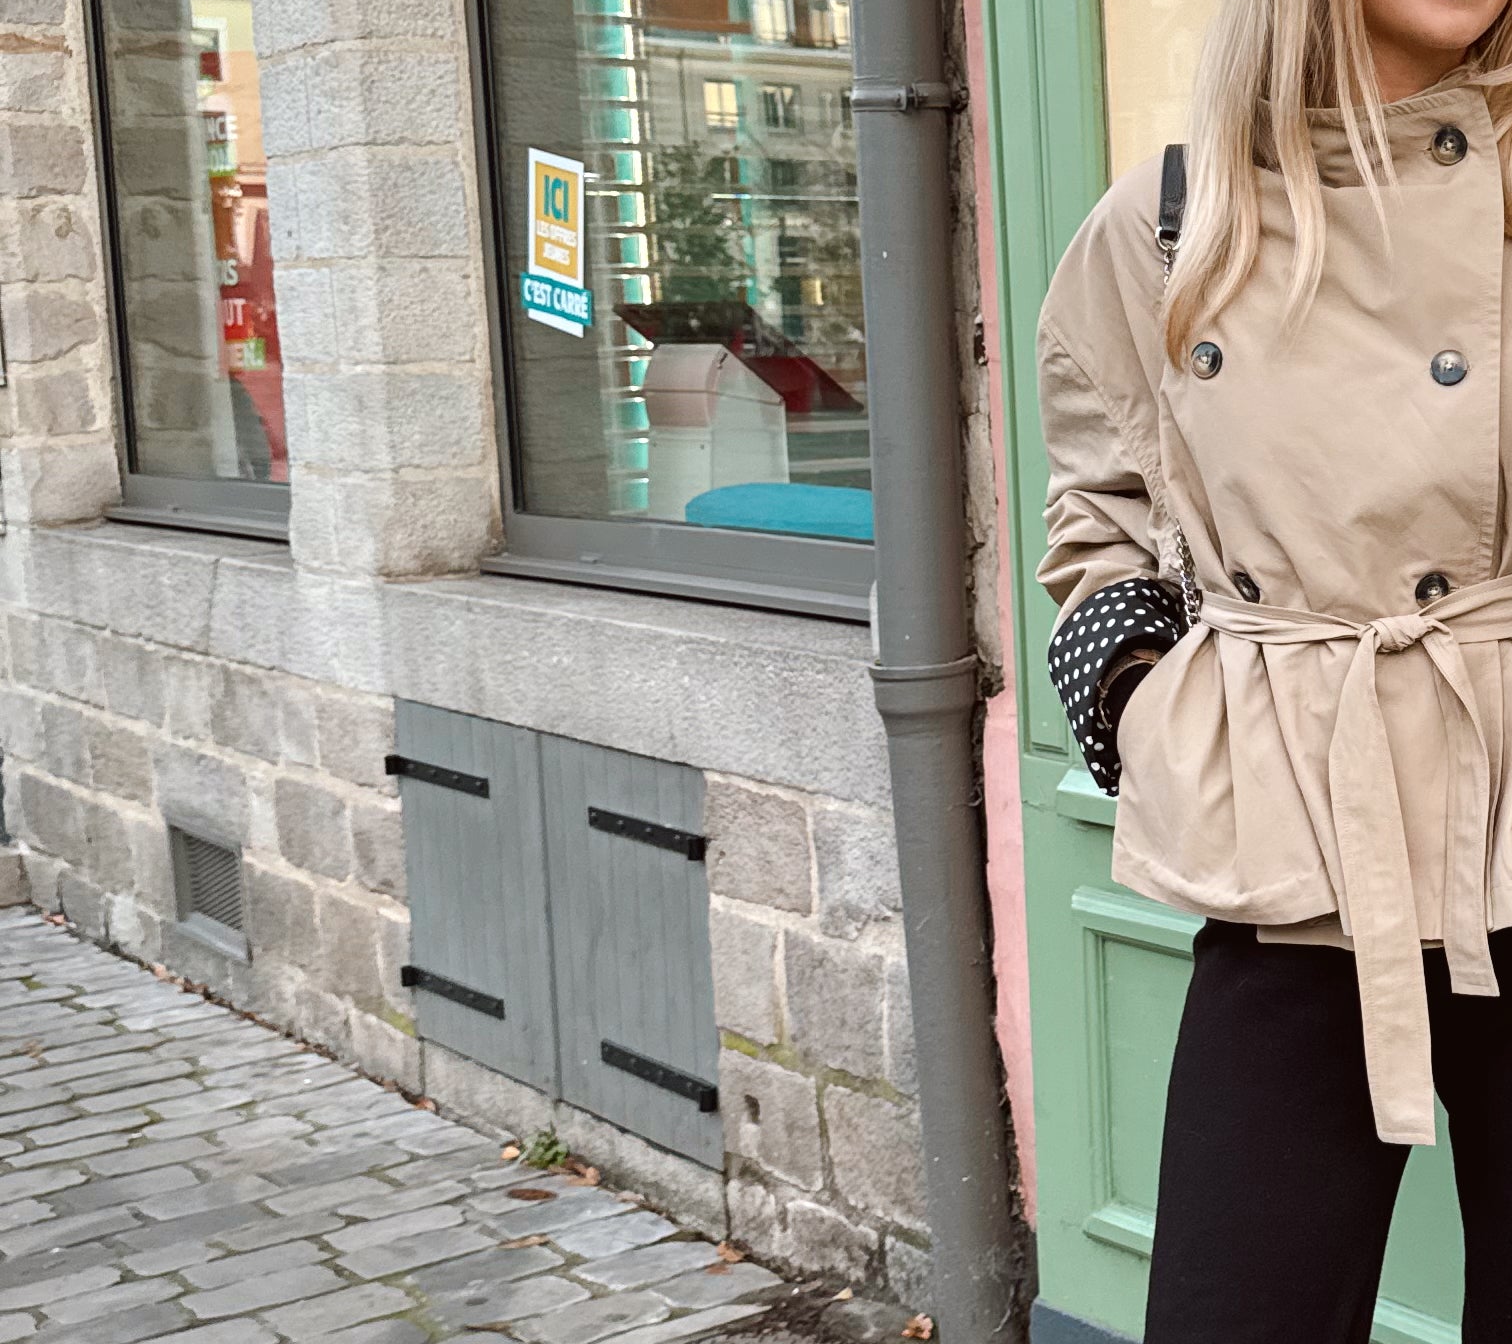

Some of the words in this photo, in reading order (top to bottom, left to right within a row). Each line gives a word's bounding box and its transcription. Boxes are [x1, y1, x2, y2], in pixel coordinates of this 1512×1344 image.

[543, 174, 570, 224] ICI
[524, 278, 553, 309] C'EST
[553, 286, 590, 321] CARRÉ
